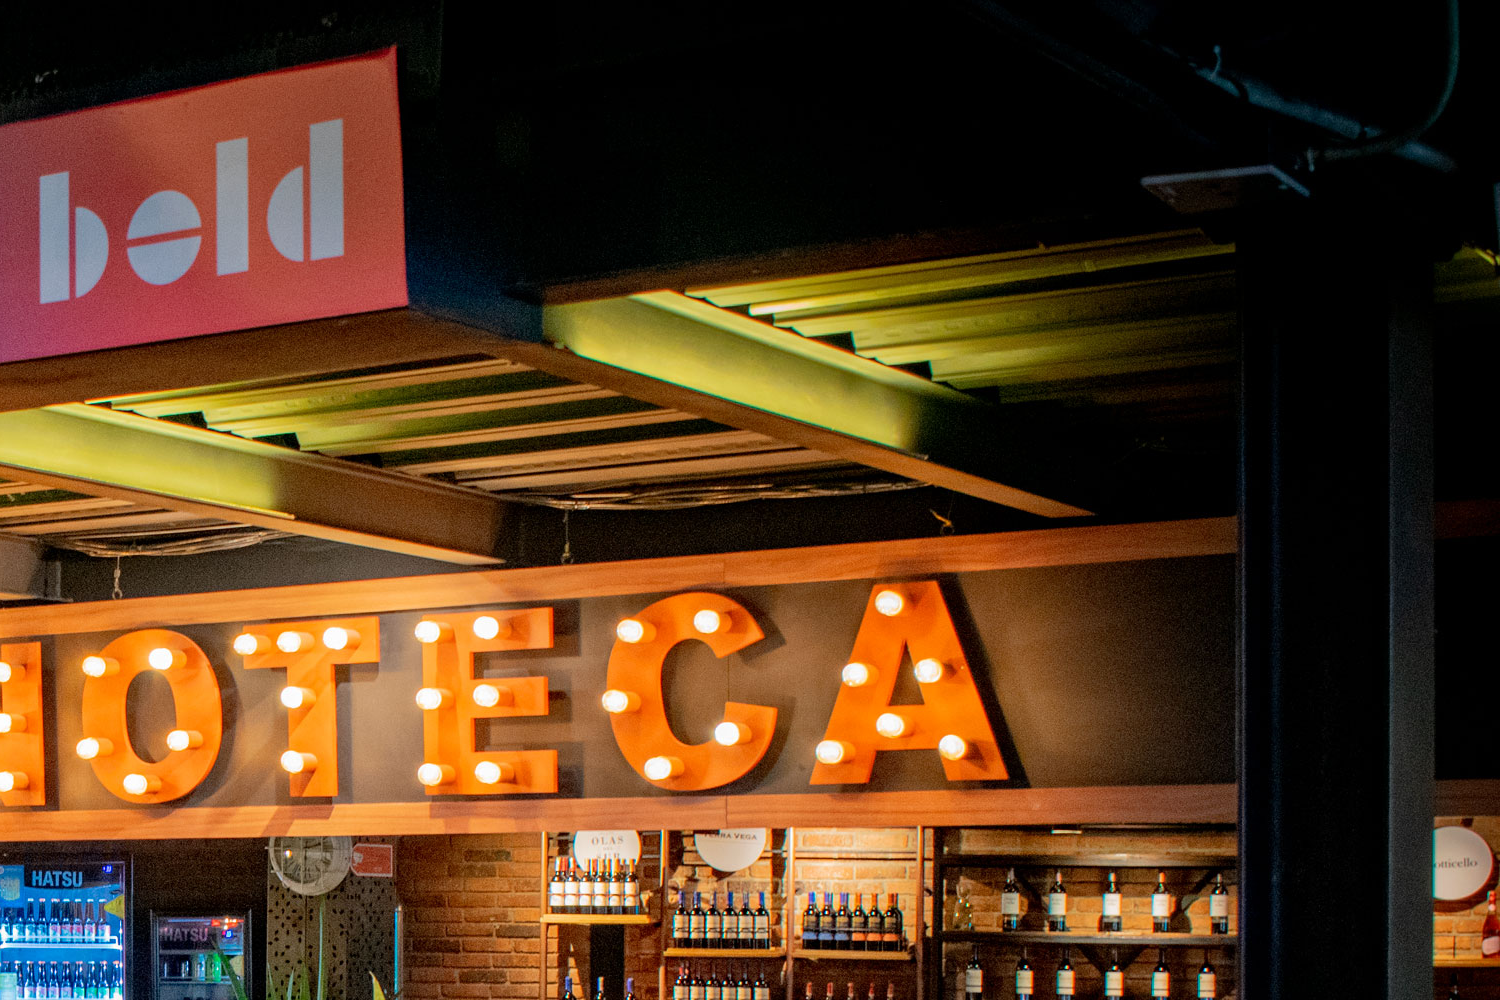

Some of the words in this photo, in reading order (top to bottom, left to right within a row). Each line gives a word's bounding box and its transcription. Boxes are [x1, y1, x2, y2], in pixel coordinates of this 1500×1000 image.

[39, 118, 345, 305] bold
[591, 835, 624, 846] OLAS
[733, 832, 758, 841] VEGA
[1433, 857, 1478, 869] otticello
[31, 870, 84, 888] HATSU
[164, 927, 209, 942] HATSU
